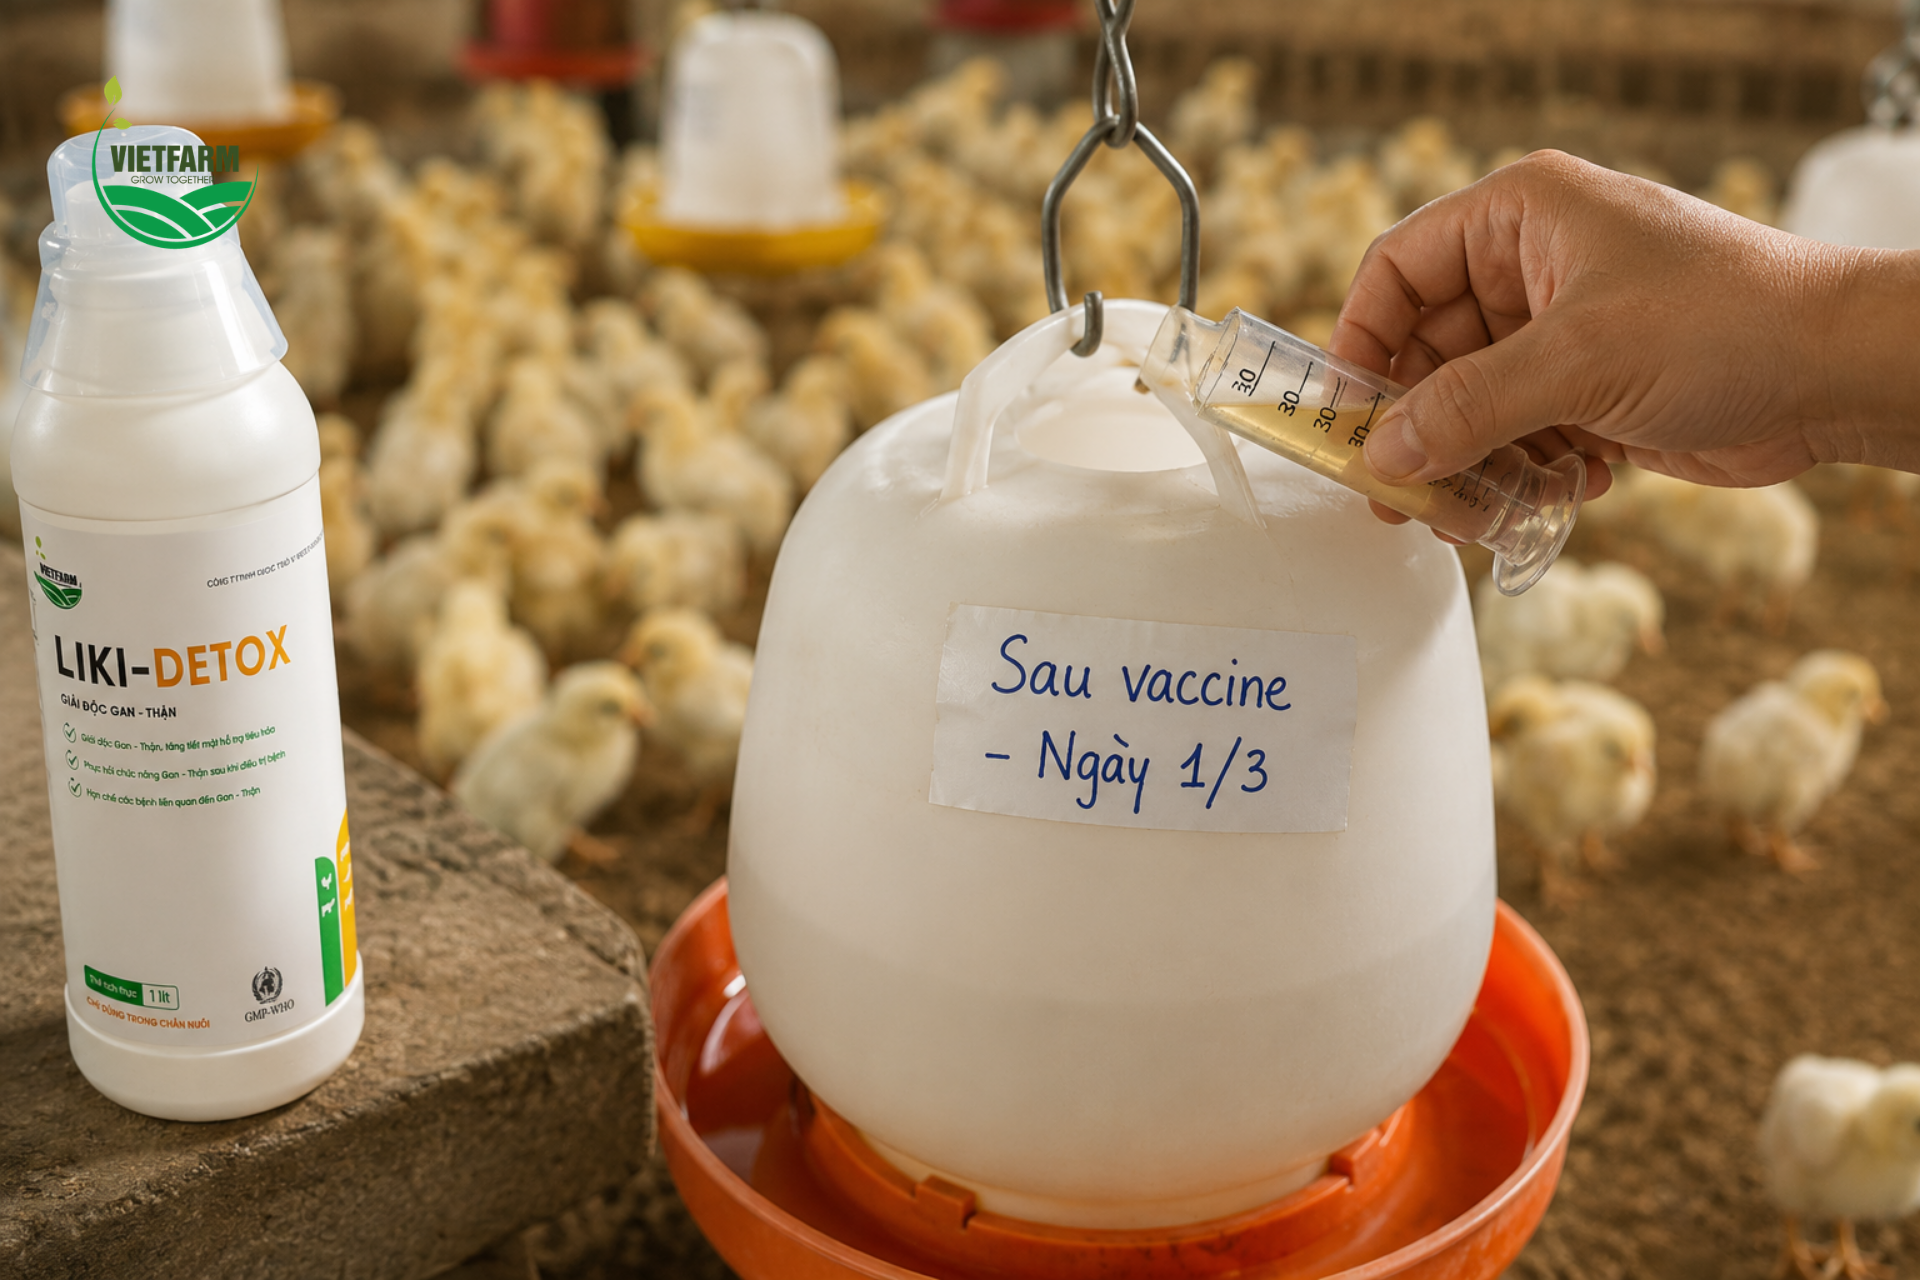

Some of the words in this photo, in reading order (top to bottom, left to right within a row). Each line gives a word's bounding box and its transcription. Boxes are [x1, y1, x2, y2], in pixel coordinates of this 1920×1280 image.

[54, 624, 291, 688] LIKI-DETOX
[991, 633, 1092, 699] Sau
[1121, 657, 1292, 711] vaccine
[60, 693, 81, 709] GIẢI
[82, 699, 108, 716] ĐỘC
[110, 705, 136, 718] GAN
[145, 705, 177, 720] THẬN
[1038, 729, 1151, 814] Ngày
[1179, 736, 1269, 810] 1/3
[126, 1012, 158, 1027] TRONG
[244, 998, 296, 1023] GMP-WHO
